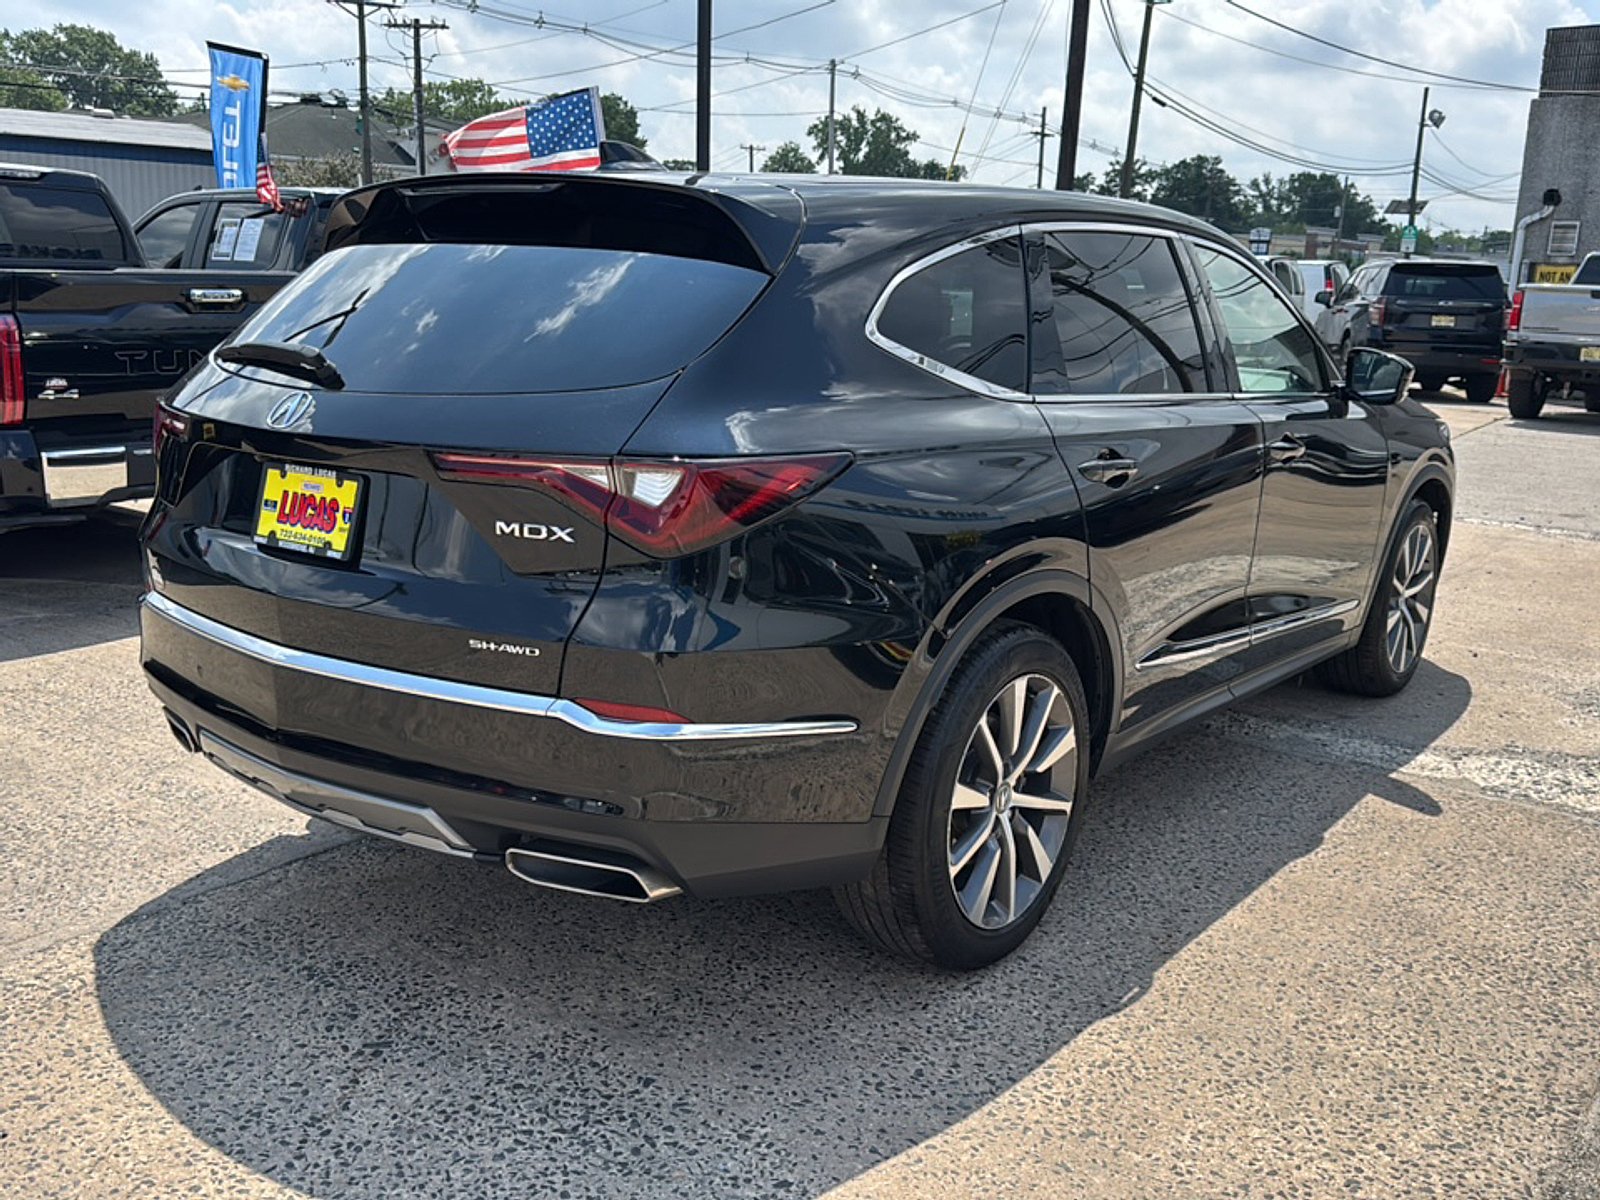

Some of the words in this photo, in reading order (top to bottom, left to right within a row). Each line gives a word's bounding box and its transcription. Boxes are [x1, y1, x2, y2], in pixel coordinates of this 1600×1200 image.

[1538, 271, 1556, 283] NOT
[277, 490, 340, 534] LUCAS
[494, 520, 575, 543] MDX
[468, 639, 540, 657] SH-AWD
